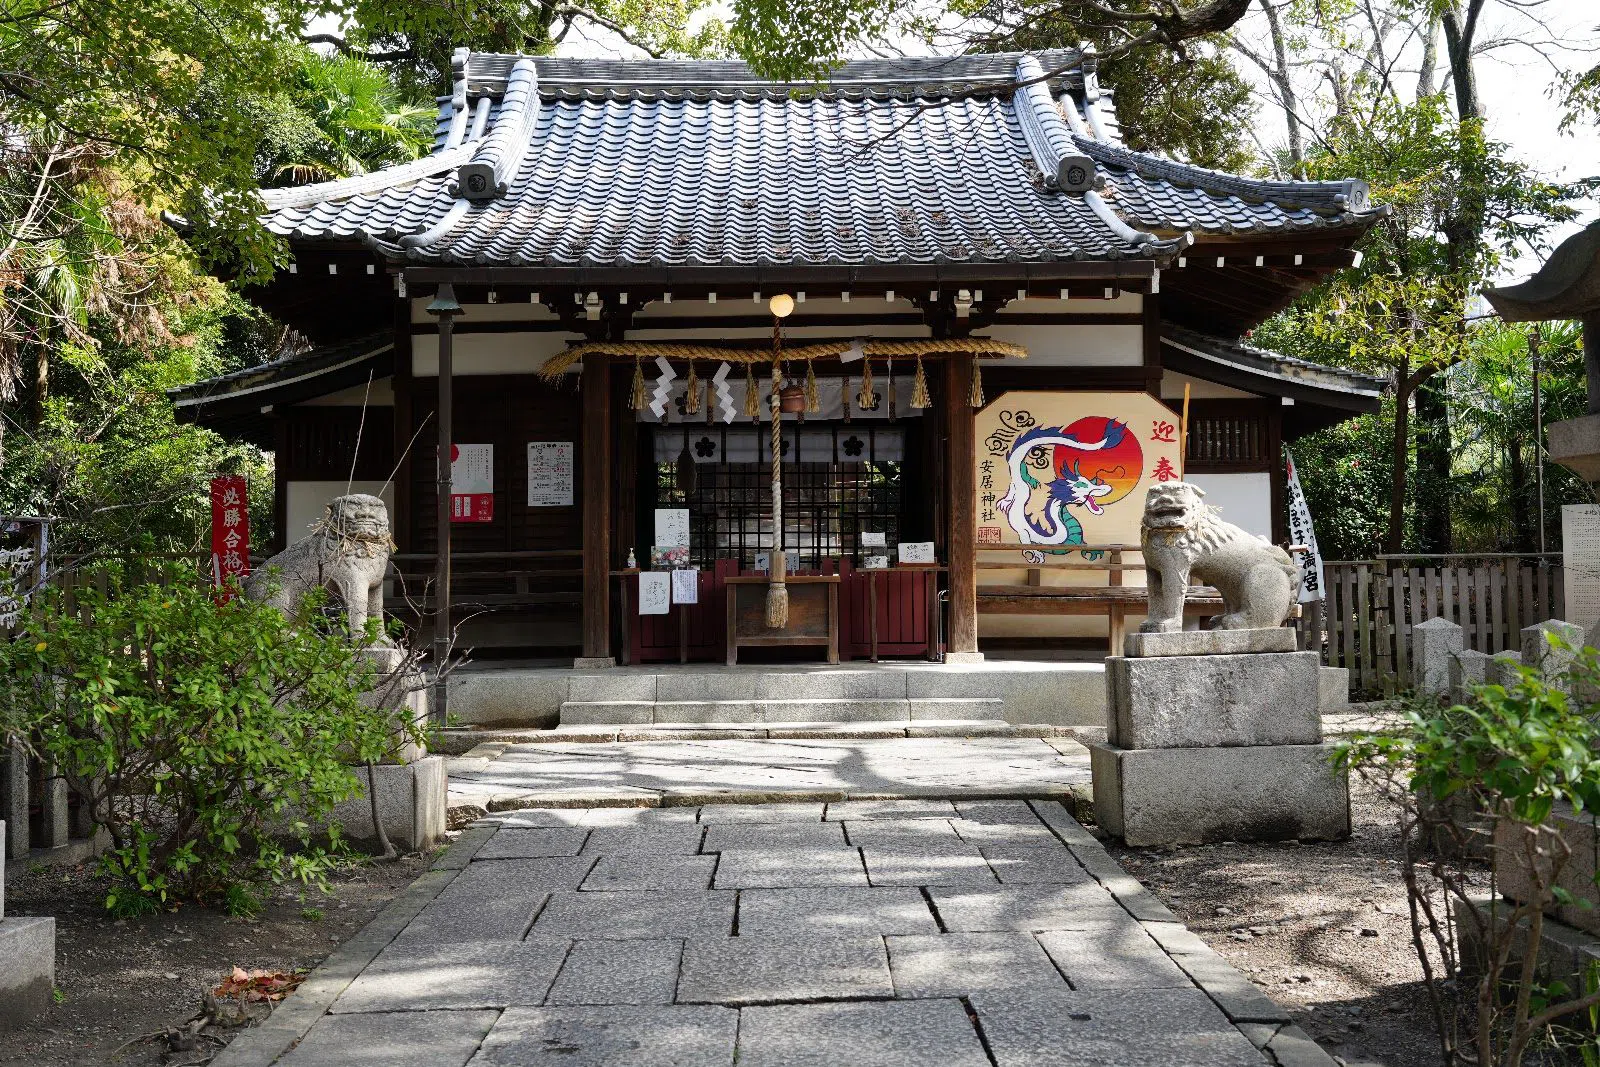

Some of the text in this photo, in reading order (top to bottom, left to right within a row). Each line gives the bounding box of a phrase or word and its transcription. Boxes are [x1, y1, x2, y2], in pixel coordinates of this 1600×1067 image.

[1150, 420, 1178, 481] 迎春
[979, 460, 996, 523] 安居神社
[223, 486, 242, 569] 必勝合格
